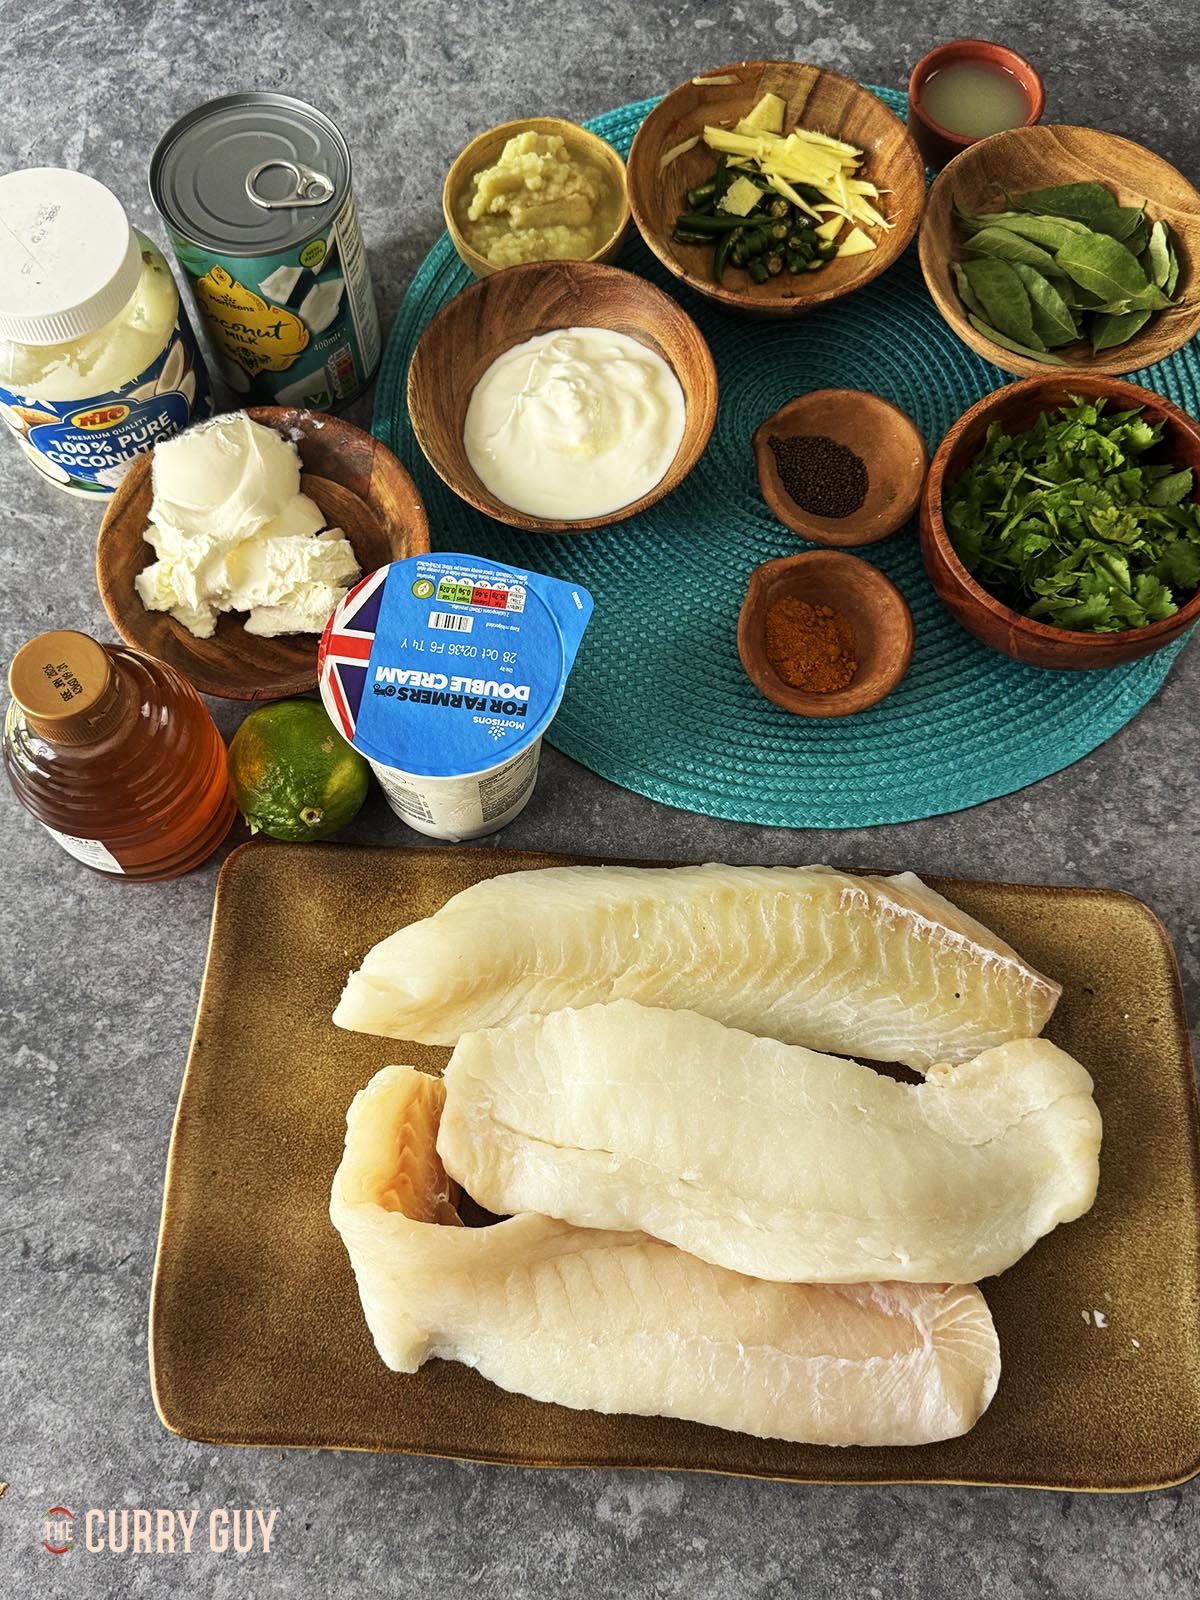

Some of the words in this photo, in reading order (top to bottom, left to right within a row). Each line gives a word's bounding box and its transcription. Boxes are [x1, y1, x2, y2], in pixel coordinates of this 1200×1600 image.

[210, 294, 254, 312] Morrisons
[225, 330, 258, 345] MILK
[78, 407, 124, 427] KTC
[50, 440, 112, 453] 100%
[118, 411, 171, 448] PURE
[66, 432, 110, 441] PREMIUM
[114, 416, 148, 435] QUALITY
[47, 440, 153, 467] COCONUT
[439, 584, 456, 595] 0.02g
[458, 587, 470, 597] 0.5g
[401, 638, 408, 649] Y
[412, 639, 425, 650] T4
[431, 642, 445, 653] F6
[448, 643, 477, 657] 02:36
[482, 648, 499, 661] Oct
[503, 652, 517, 663] 28
[375, 665, 448, 689] CREAM
[449, 676, 530, 700] DOUBLE
[397, 687, 487, 713] FARMERS
[490, 700, 528, 716] FOR
[473, 715, 525, 731] Morrisons
